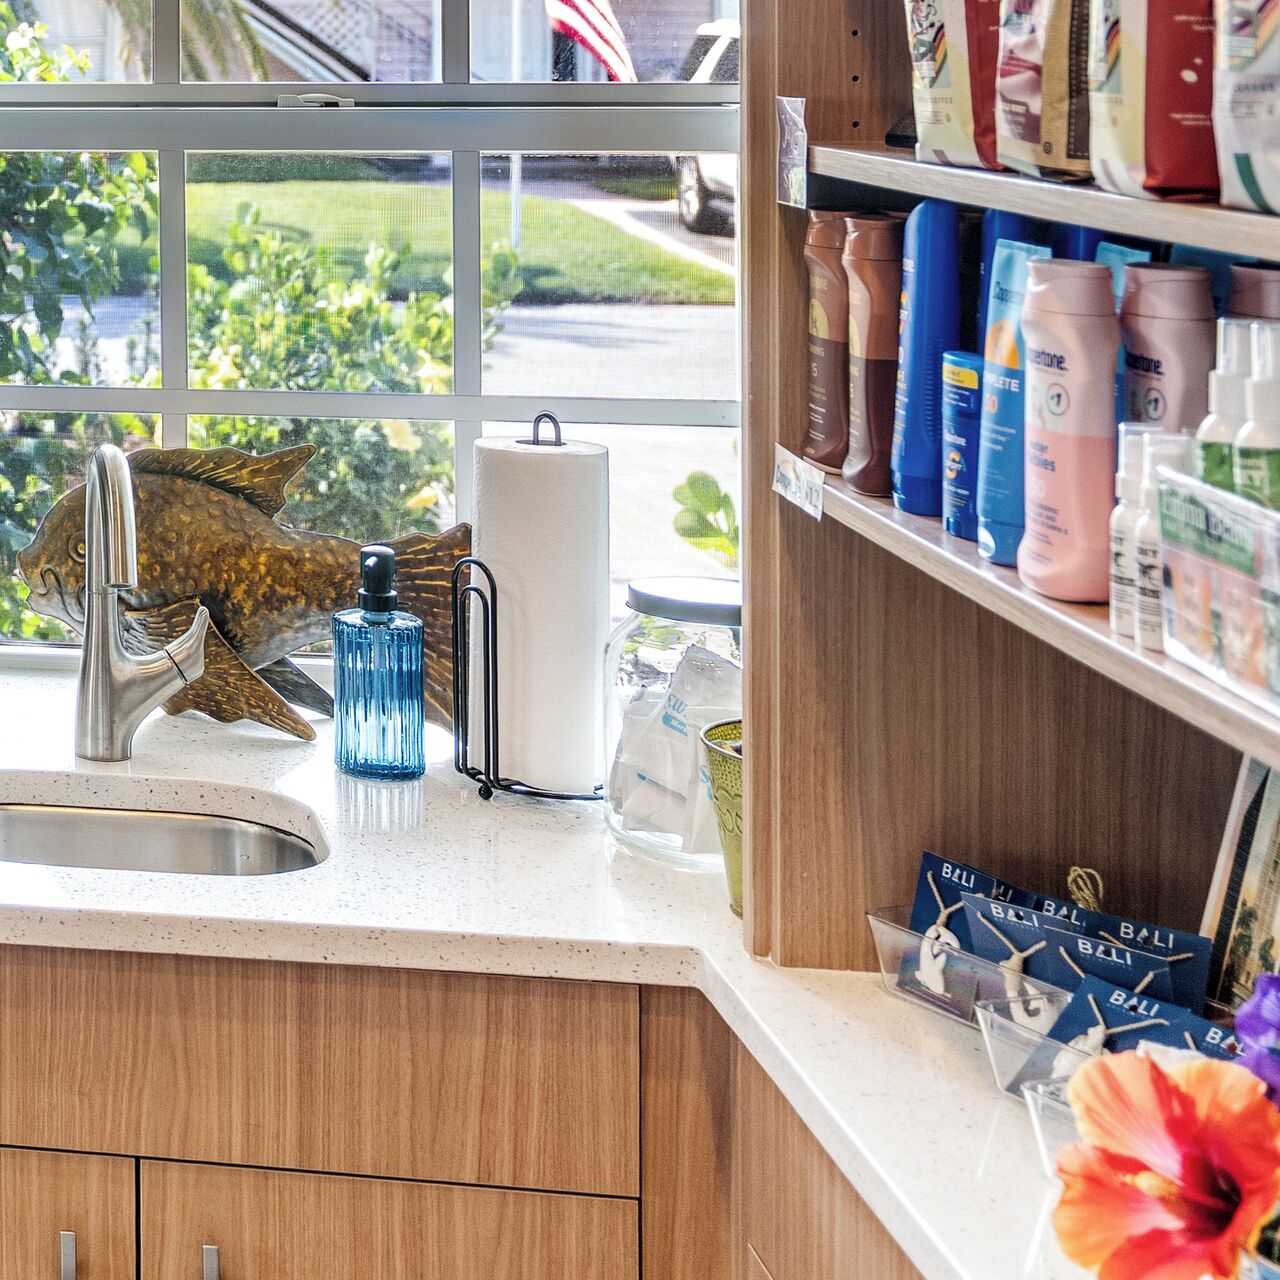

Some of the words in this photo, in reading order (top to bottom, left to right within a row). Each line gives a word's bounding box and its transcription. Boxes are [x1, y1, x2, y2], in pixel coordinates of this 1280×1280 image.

[941, 863, 974, 888] BALI
[989, 902, 1039, 928] BALI
[1119, 921, 1174, 949] BALI
[1077, 938, 1132, 966] BALI
[1108, 990, 1160, 1017] BALI
[1205, 1027, 1247, 1056] BAL
